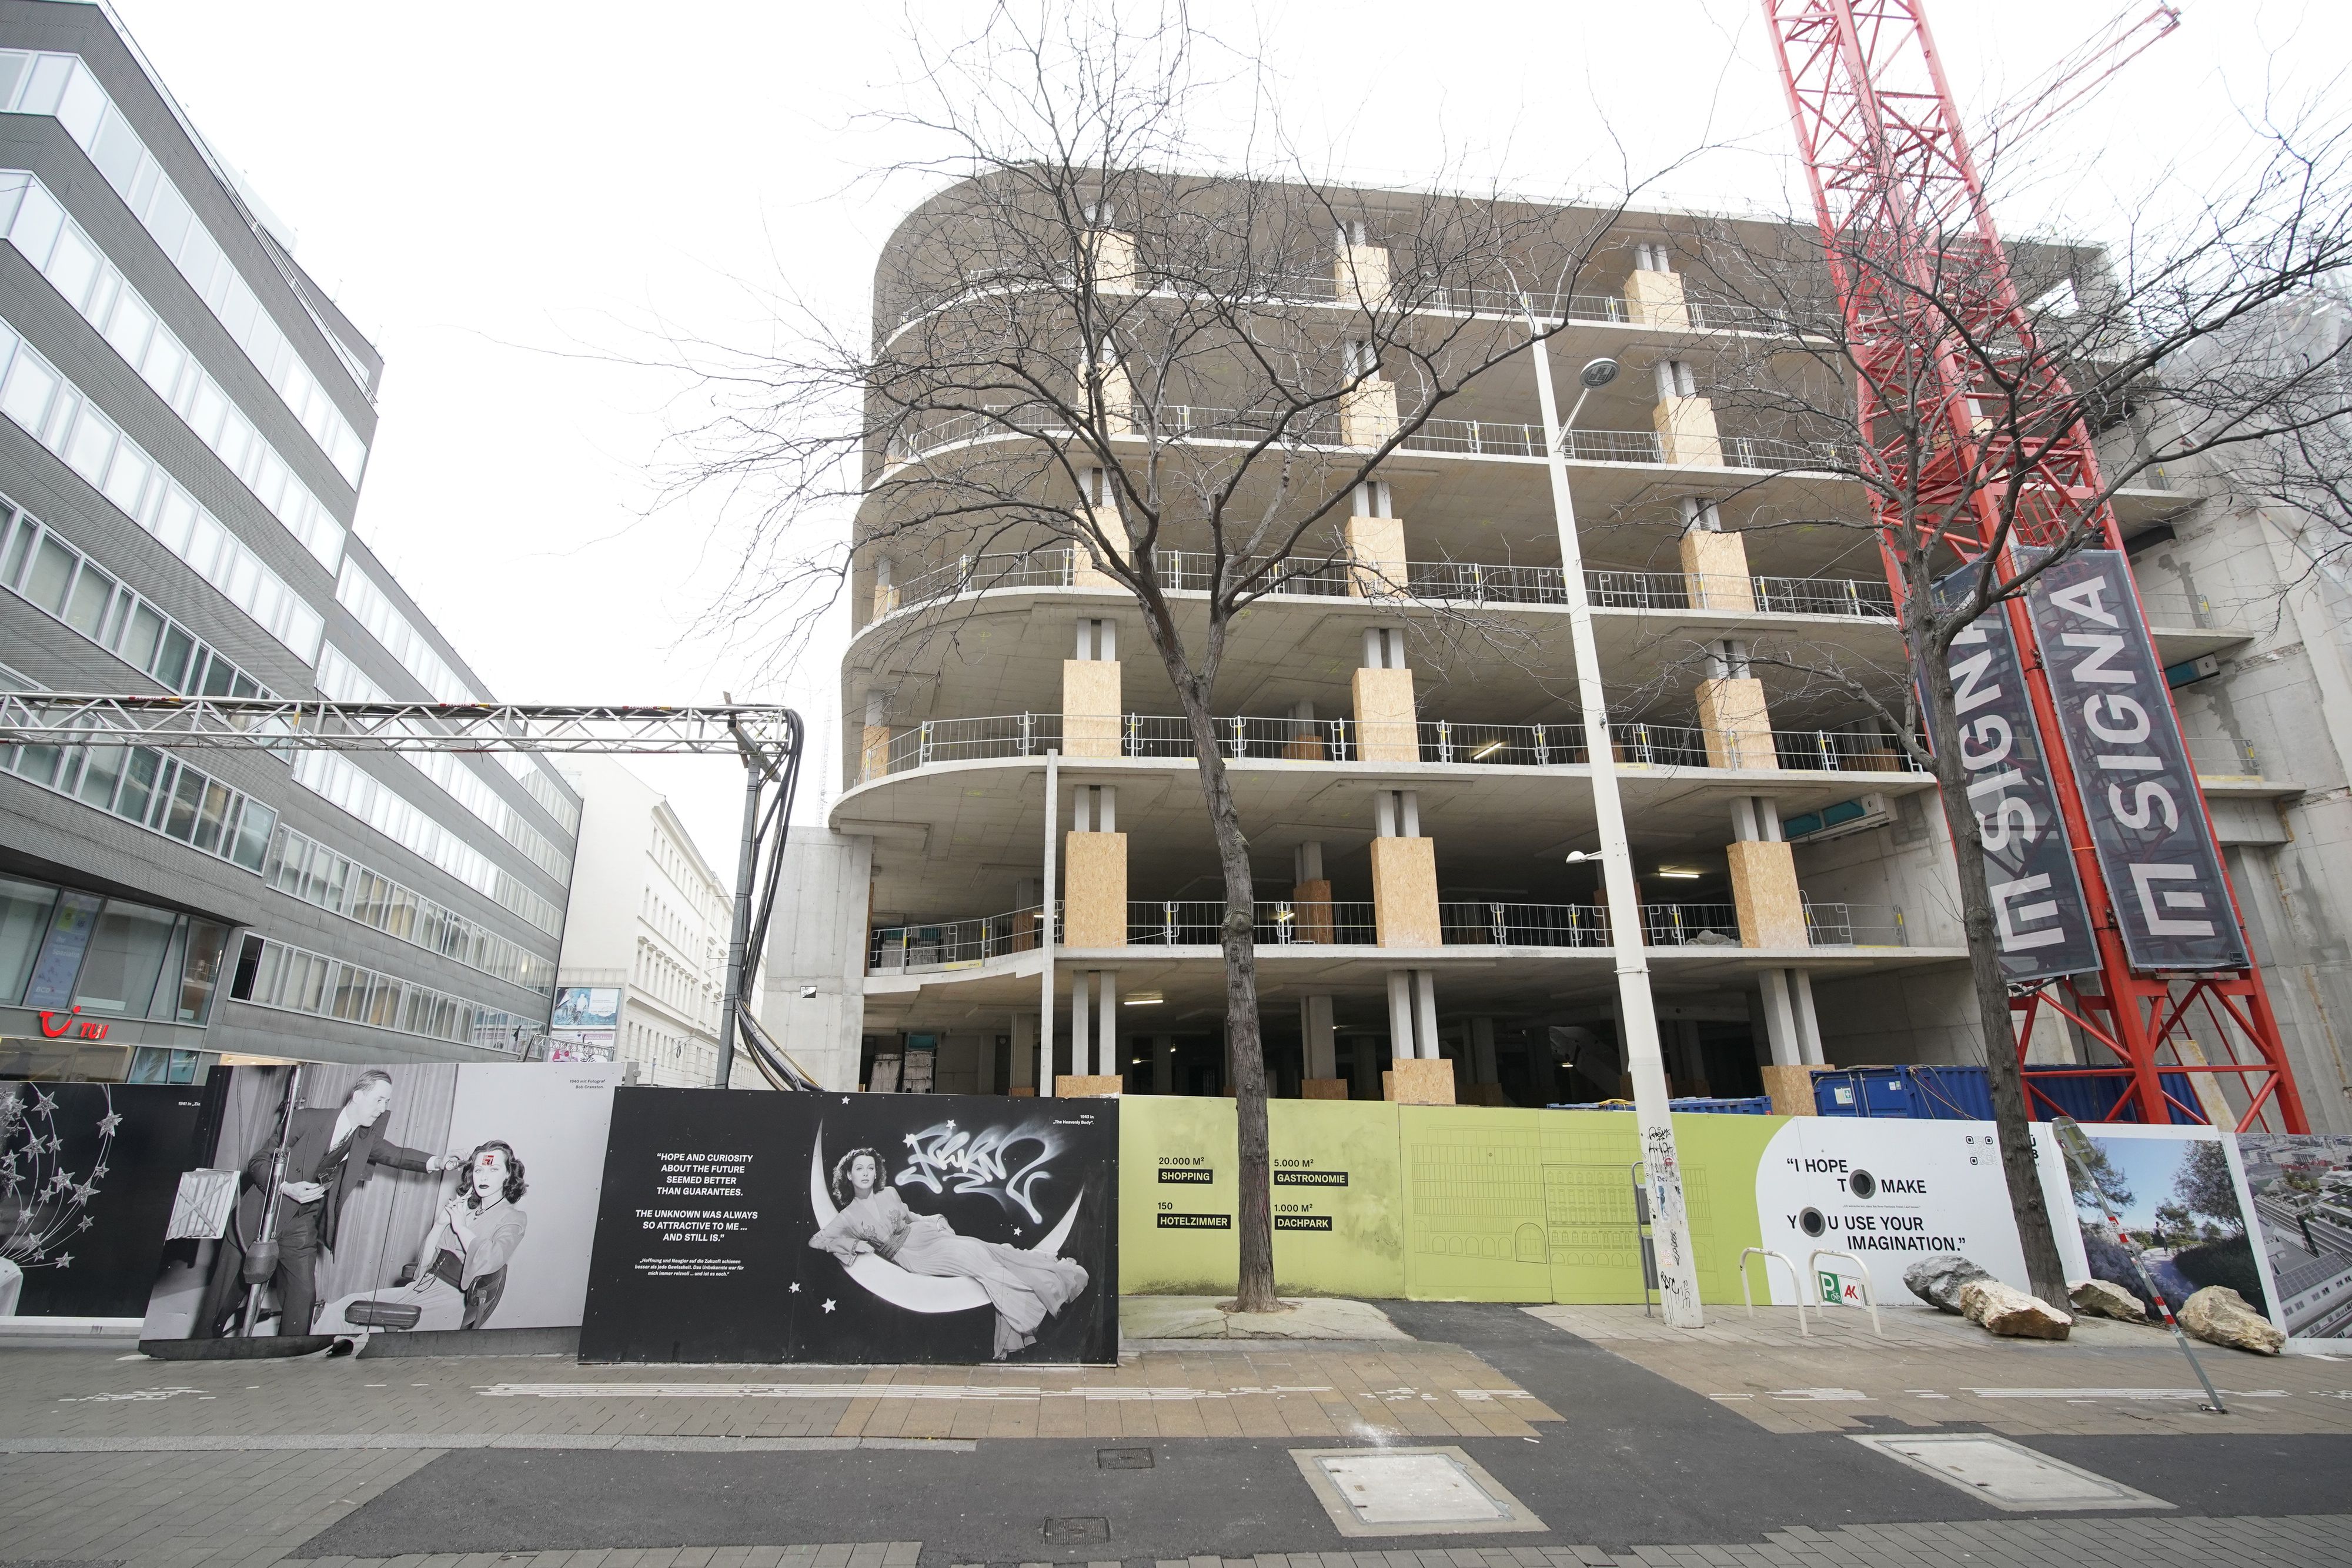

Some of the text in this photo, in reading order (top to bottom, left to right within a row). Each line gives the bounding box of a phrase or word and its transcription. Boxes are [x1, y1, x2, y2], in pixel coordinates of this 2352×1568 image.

[2049, 575, 2179, 833] SIGNA
[81, 1022, 109, 1039] TUI
[707, 1154, 753, 1162] CURIOSITY
[1158, 1157, 1190, 1165] 20.000
[661, 1164, 691, 1172] ABOUT
[1274, 1159, 1299, 1168] 5.000
[1805, 1159, 1849, 1174] HOPE
[1161, 1172, 1210, 1182] SHOPPING
[1277, 1174, 1345, 1183] GASTRONOMIE
[1881, 1179, 1927, 1194] MAKE
[683, 1188, 743, 1196] GUARANTEES.
[1274, 1204, 1299, 1212] 1.000
[635, 1209, 653, 1218] THE
[654, 1210, 700, 1218] UNKNOWN
[656, 1222, 711, 1230] ATTRACTIVE
[1160, 1217, 1228, 1226] HOTELZIMMER
[1277, 1219, 1329, 1228] DACHPARK
[1845, 1216, 1876, 1231] USE
[1880, 1216, 1924, 1231] YOUR
[684, 1233, 708, 1242] STILL
[1820, 1273, 1859, 1300] P AK
